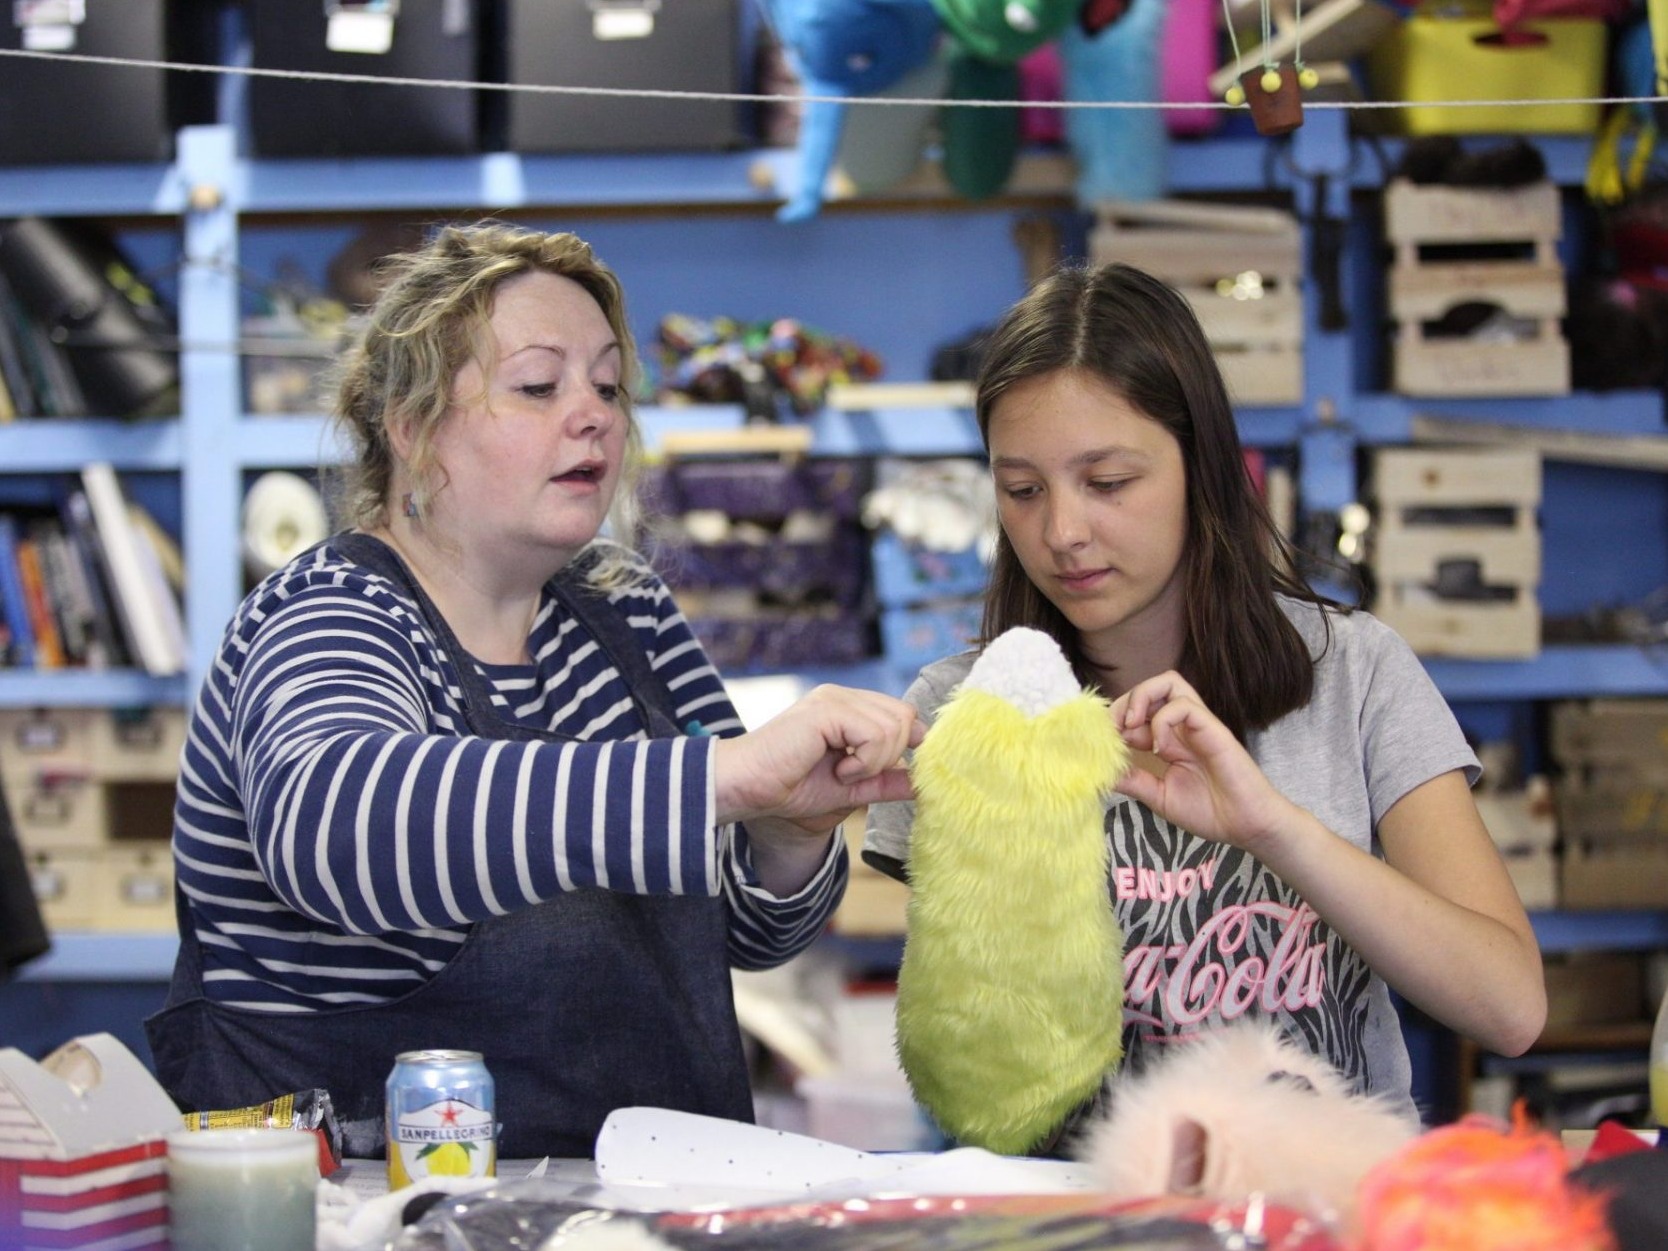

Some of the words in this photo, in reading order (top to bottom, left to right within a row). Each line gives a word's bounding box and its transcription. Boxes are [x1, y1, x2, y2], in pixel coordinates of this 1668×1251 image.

[1117, 858, 1216, 901] ENJOY
[1124, 902, 1327, 1024] a-Cola
[401, 1125, 491, 1141] SANPELLEGRINO
